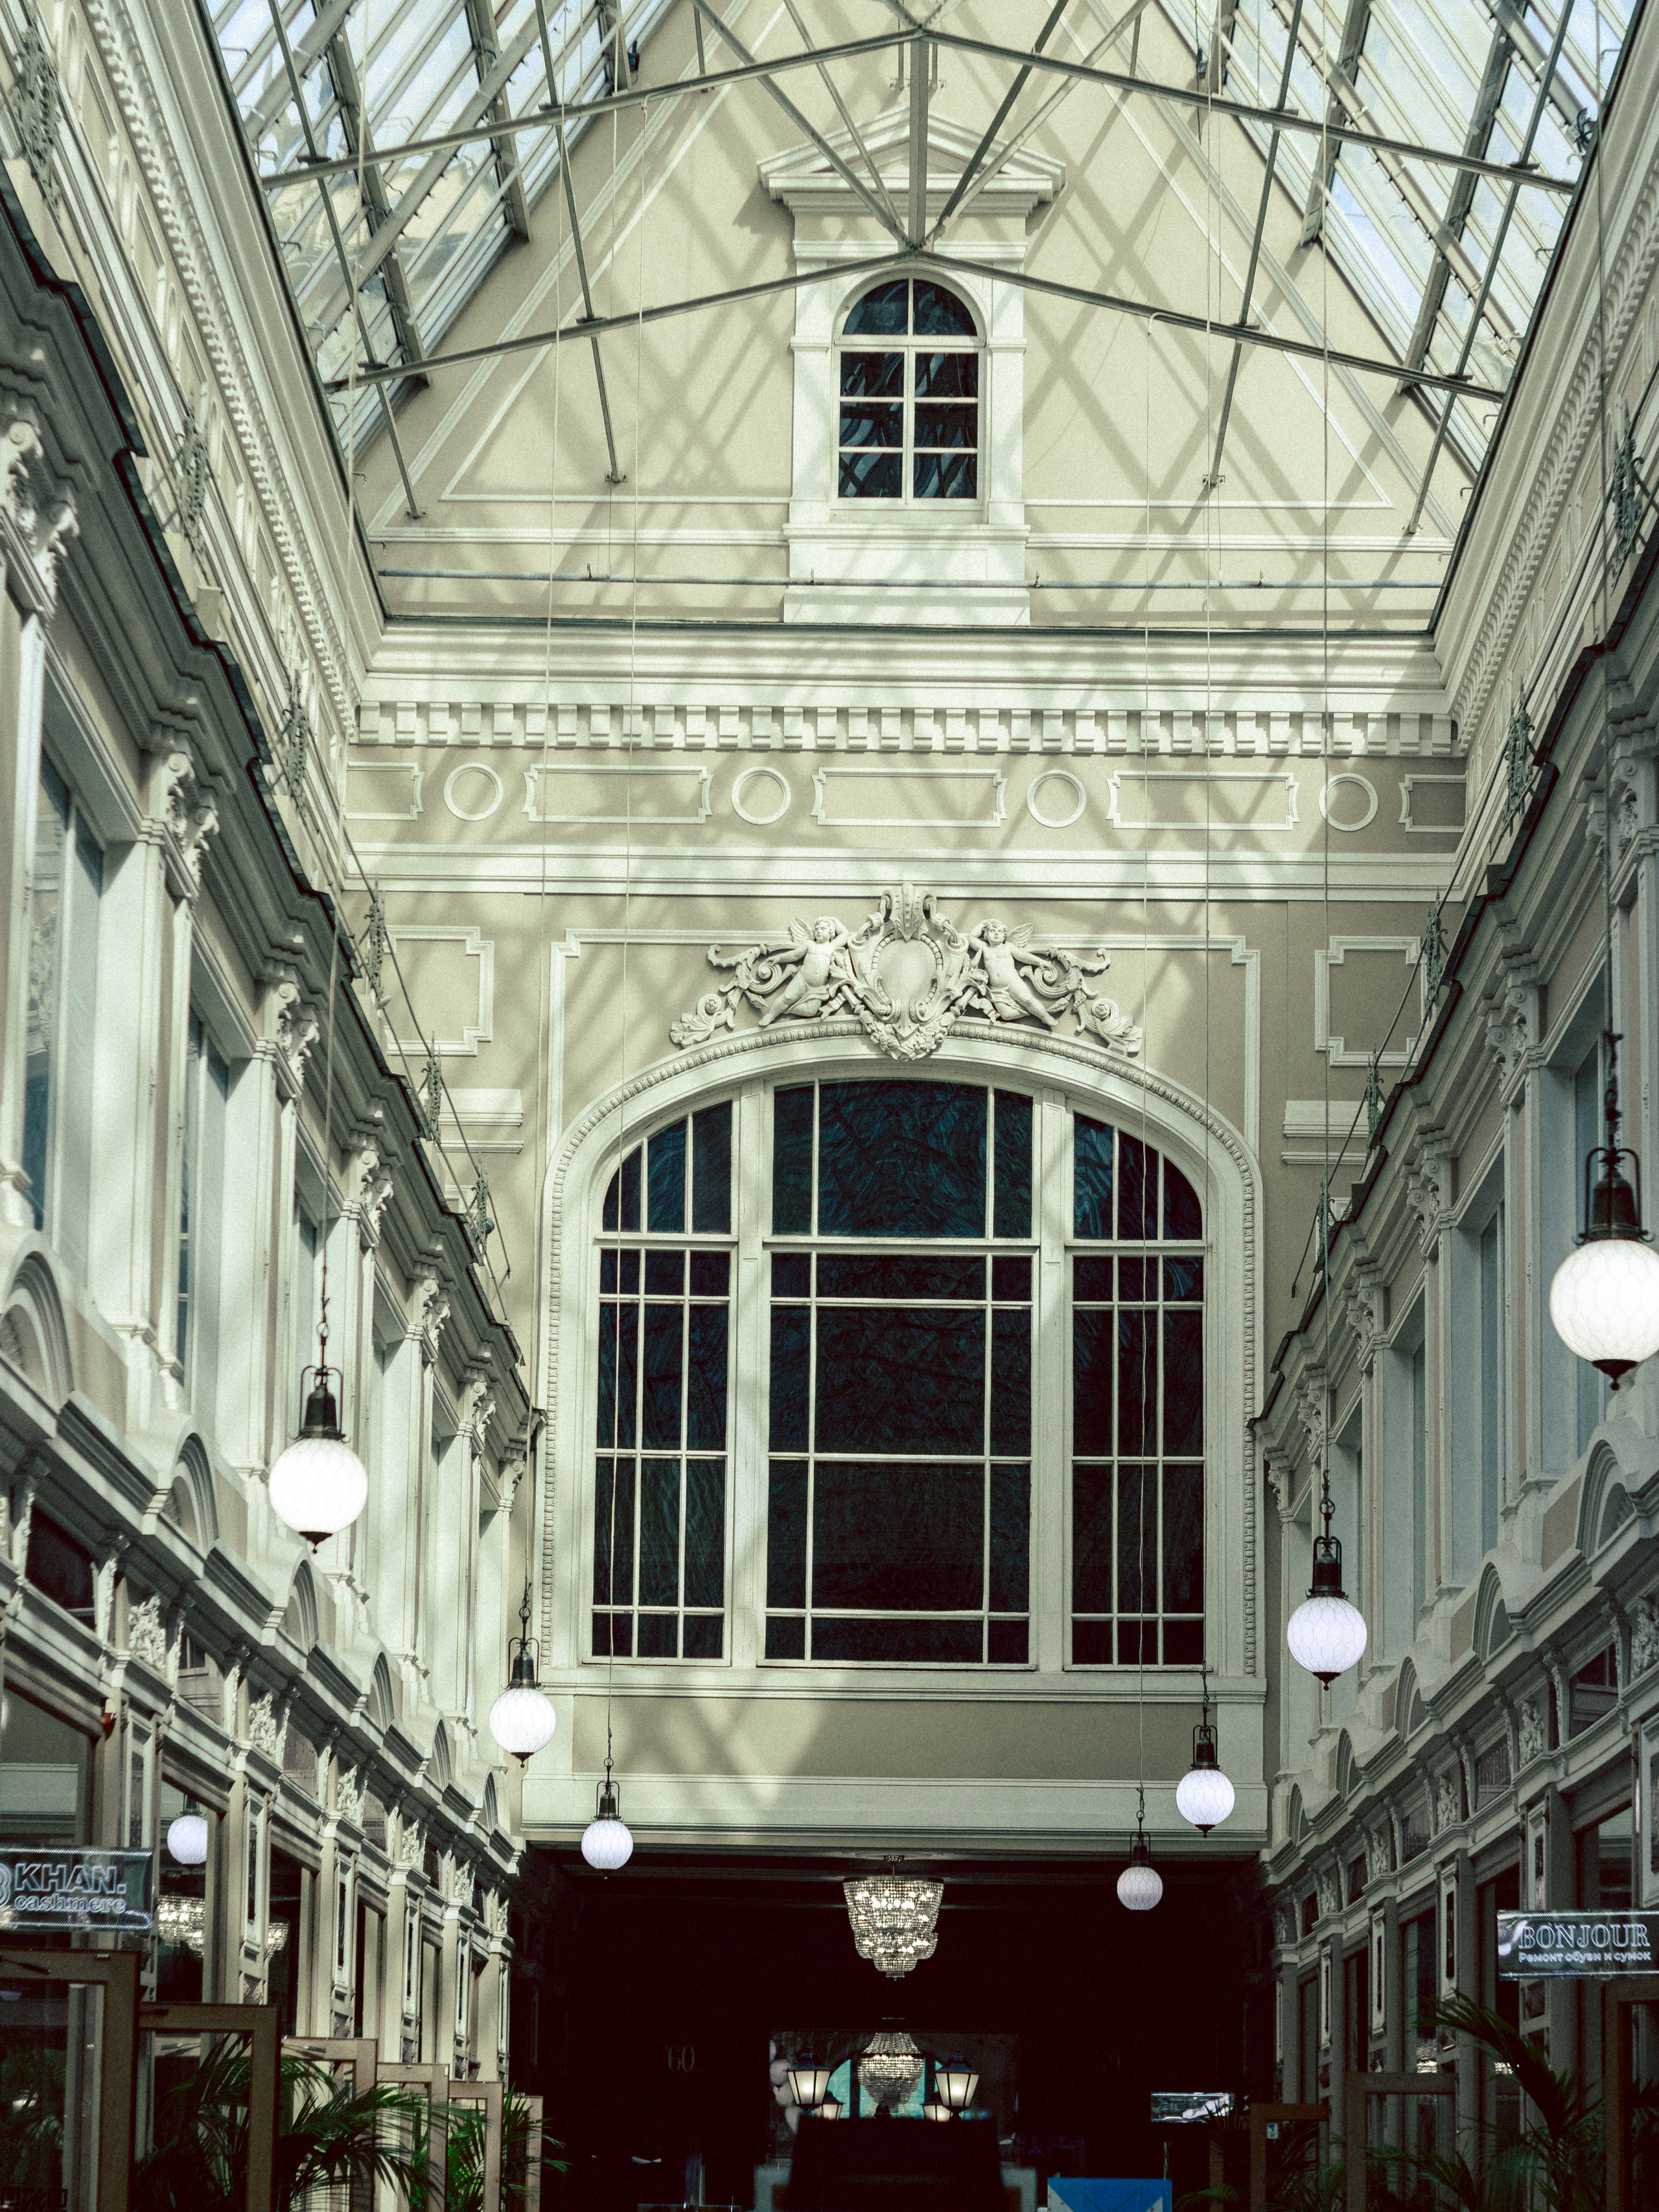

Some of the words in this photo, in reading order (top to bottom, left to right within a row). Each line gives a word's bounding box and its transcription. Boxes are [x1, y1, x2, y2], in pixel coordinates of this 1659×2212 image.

[15, 1863, 127, 1894] KHAN.
[14, 1893, 126, 1914] cashmere
[1518, 1923, 1651, 1949] BONJOUR
[1518, 1951, 1563, 1962] Ремонт
[1564, 1950, 1601, 1964] обуви
[1604, 1953, 1612, 1961] и
[1614, 1951, 1651, 1963] сумок
